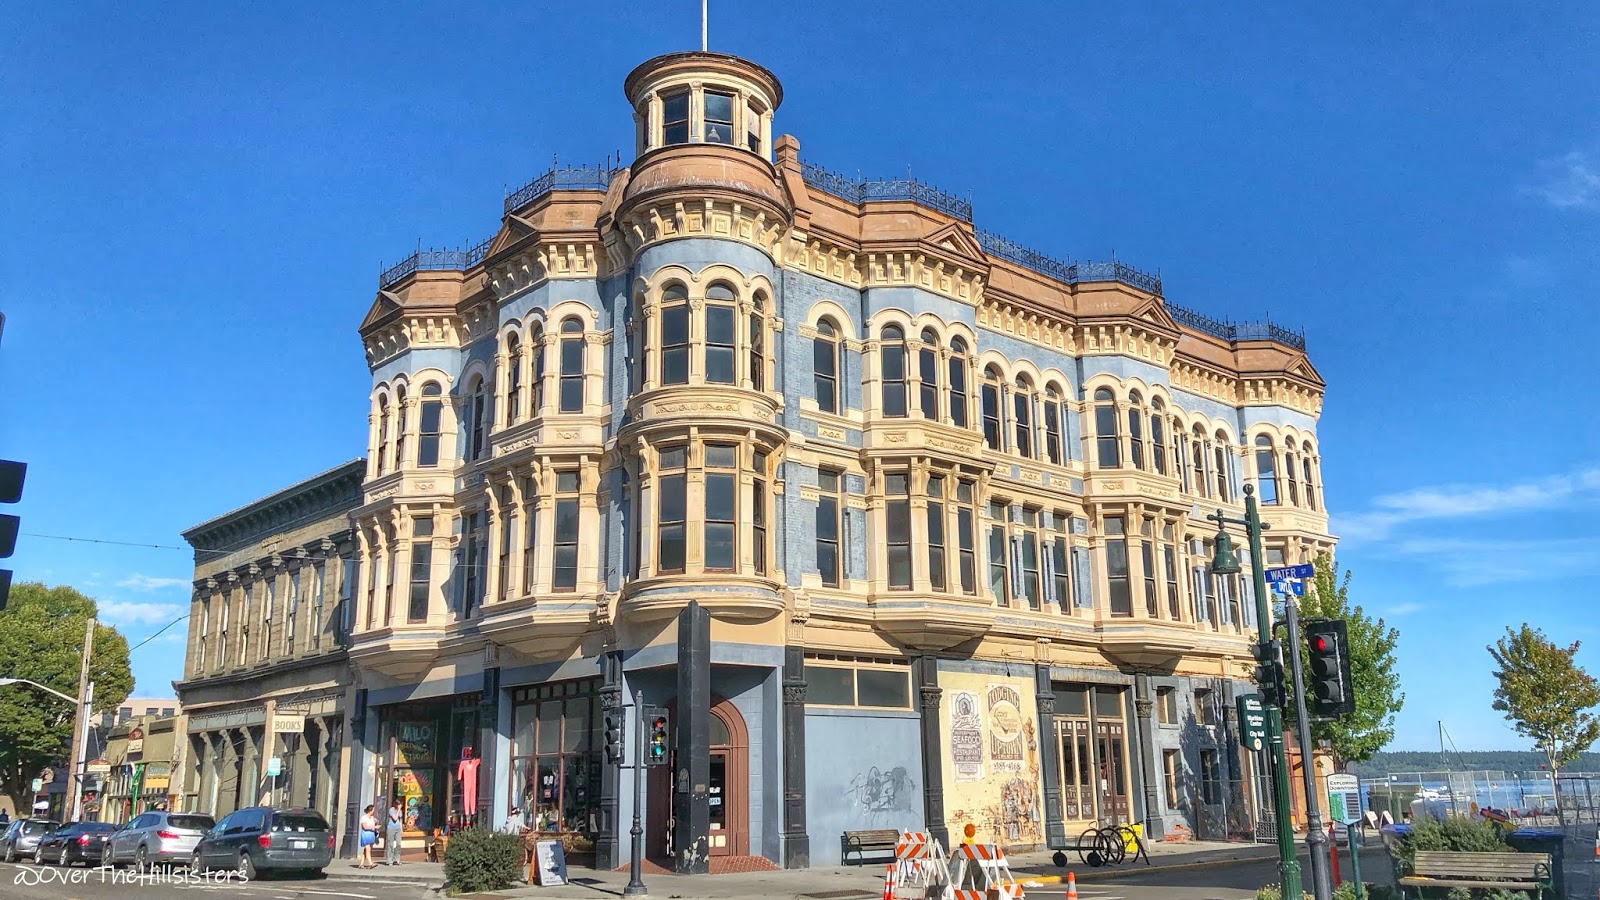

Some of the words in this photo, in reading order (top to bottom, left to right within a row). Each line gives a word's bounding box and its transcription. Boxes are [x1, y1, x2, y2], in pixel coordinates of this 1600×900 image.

[1270, 567, 1297, 580] WATER
[988, 686, 1020, 708] LODGING
[274, 720, 302, 730] BOOKS
[953, 735, 980, 744] SEAFOOD
[990, 731, 1022, 755] UPTOWN
